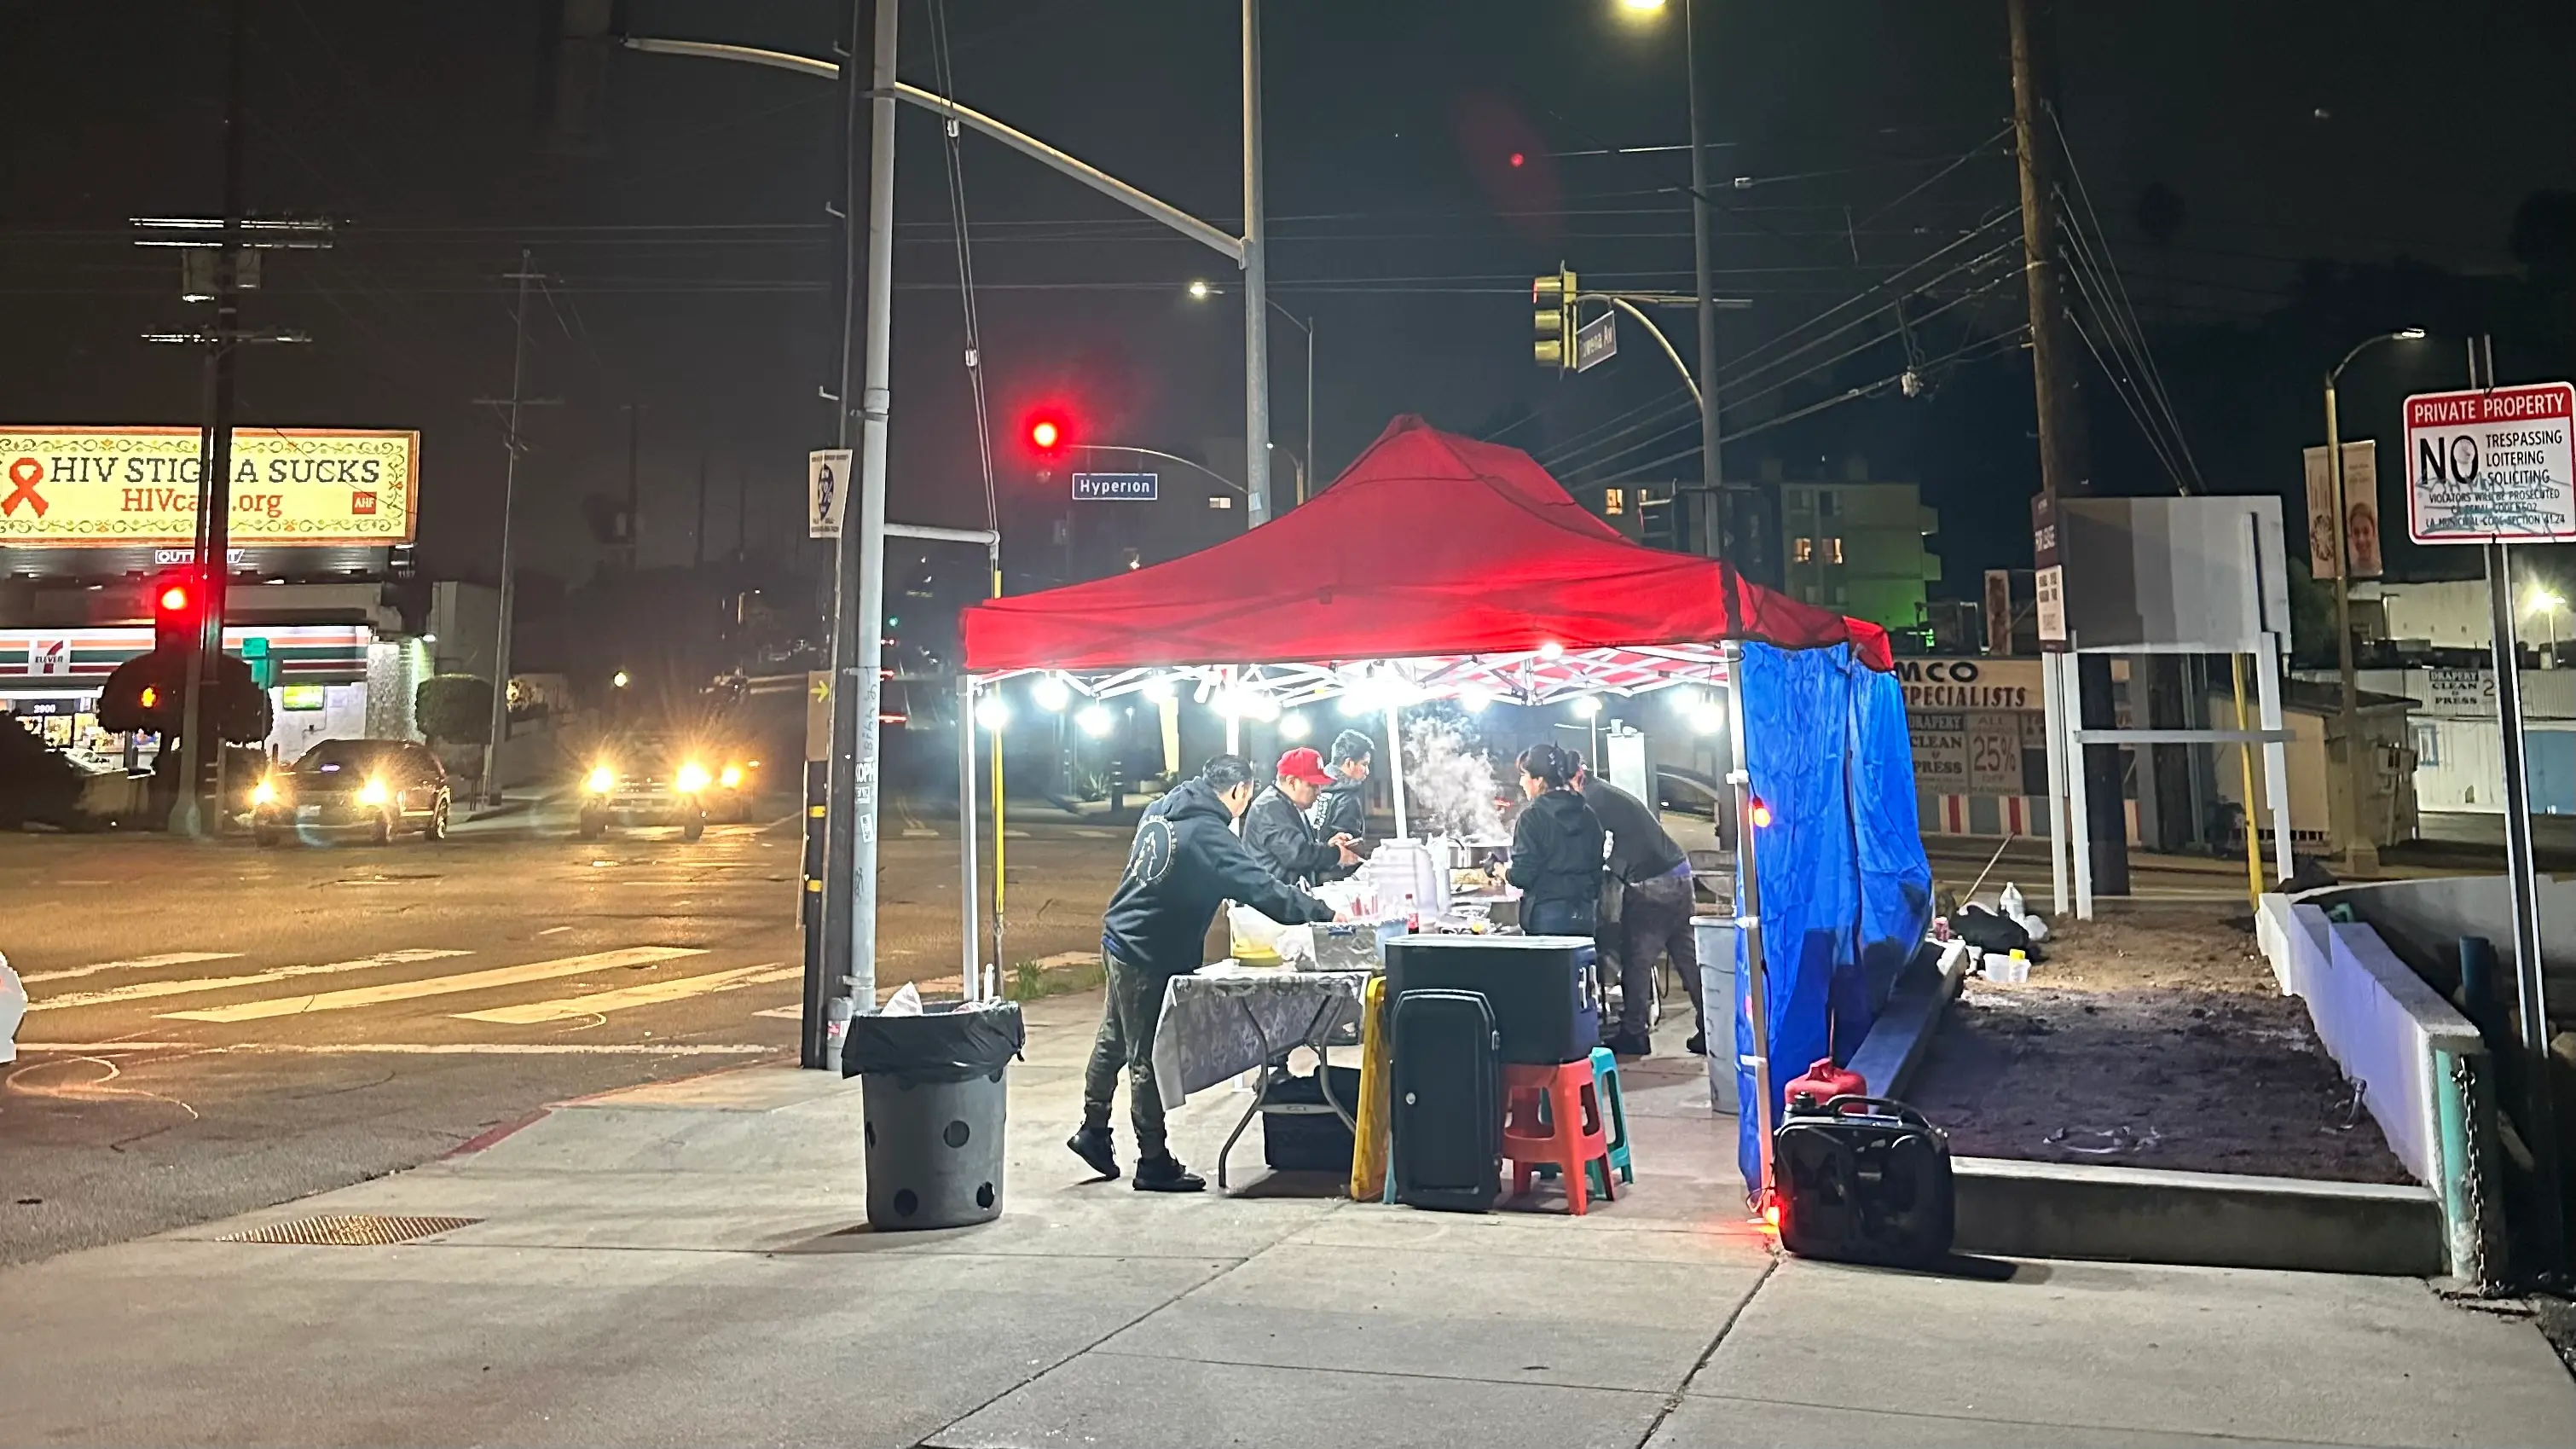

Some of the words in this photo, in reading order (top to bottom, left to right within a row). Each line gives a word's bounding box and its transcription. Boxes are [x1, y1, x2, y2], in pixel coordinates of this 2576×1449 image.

[2415, 400, 2476, 423] PRIVATE
[2483, 392, 2565, 418] PROPERTY
[2486, 429, 2563, 449] TRESPASSING
[2420, 435, 2479, 484] NO
[2486, 450, 2544, 467] LOITERING
[49, 457, 119, 483] HIV
[124, 458, 259, 484] STIGA
[269, 459, 380, 483] SUCKS
[2487, 469, 2550, 486] SOLICITING
[1080, 478, 1150, 496] Hyperion
[121, 488, 284, 519] HIVca.org
[2430, 493, 2471, 503] VIOLATORS
[2509, 490, 2560, 500] PROSECUTED
[2431, 671, 2478, 681] DRAPERY
[2435, 697, 2477, 705] PRESS
[1910, 736, 1962, 749] CLEAN
[1972, 735, 2017, 773] 25%
[1913, 760, 1963, 774] PRESS
